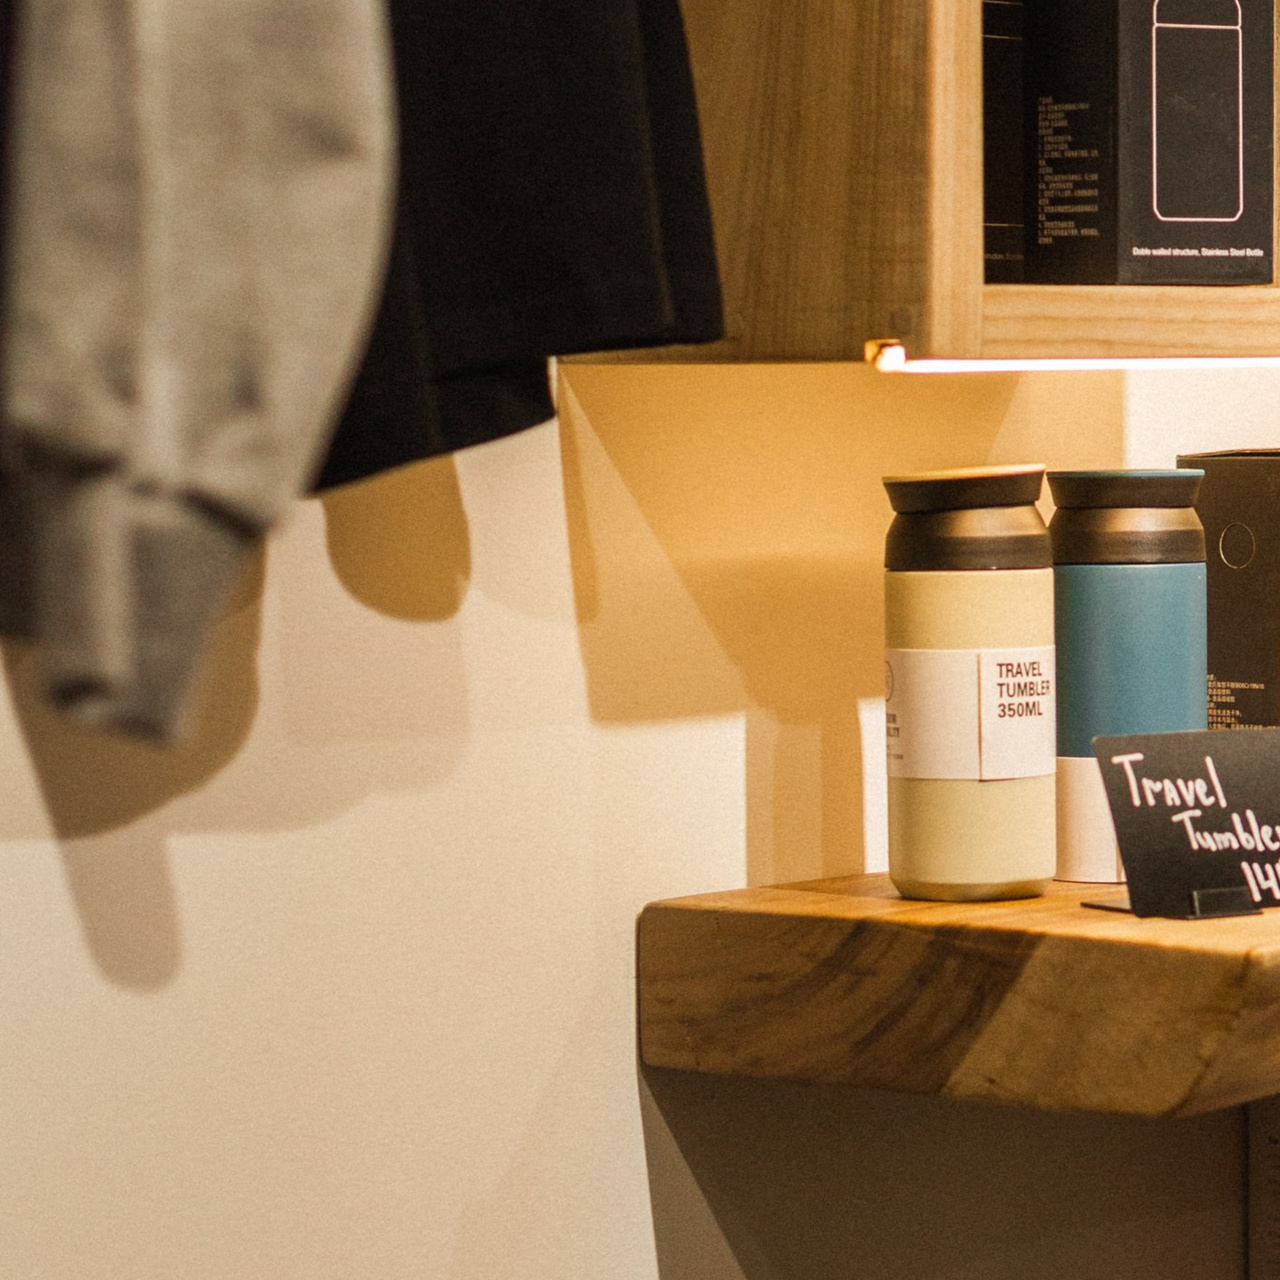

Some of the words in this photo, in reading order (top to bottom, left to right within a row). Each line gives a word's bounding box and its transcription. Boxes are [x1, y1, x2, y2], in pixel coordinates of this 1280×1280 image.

[997, 661, 1043, 678] TRAVEL
[997, 680, 1050, 698] TUMBLER
[998, 701, 1043, 718] 350ML
[1111, 752, 1227, 808] Travel
